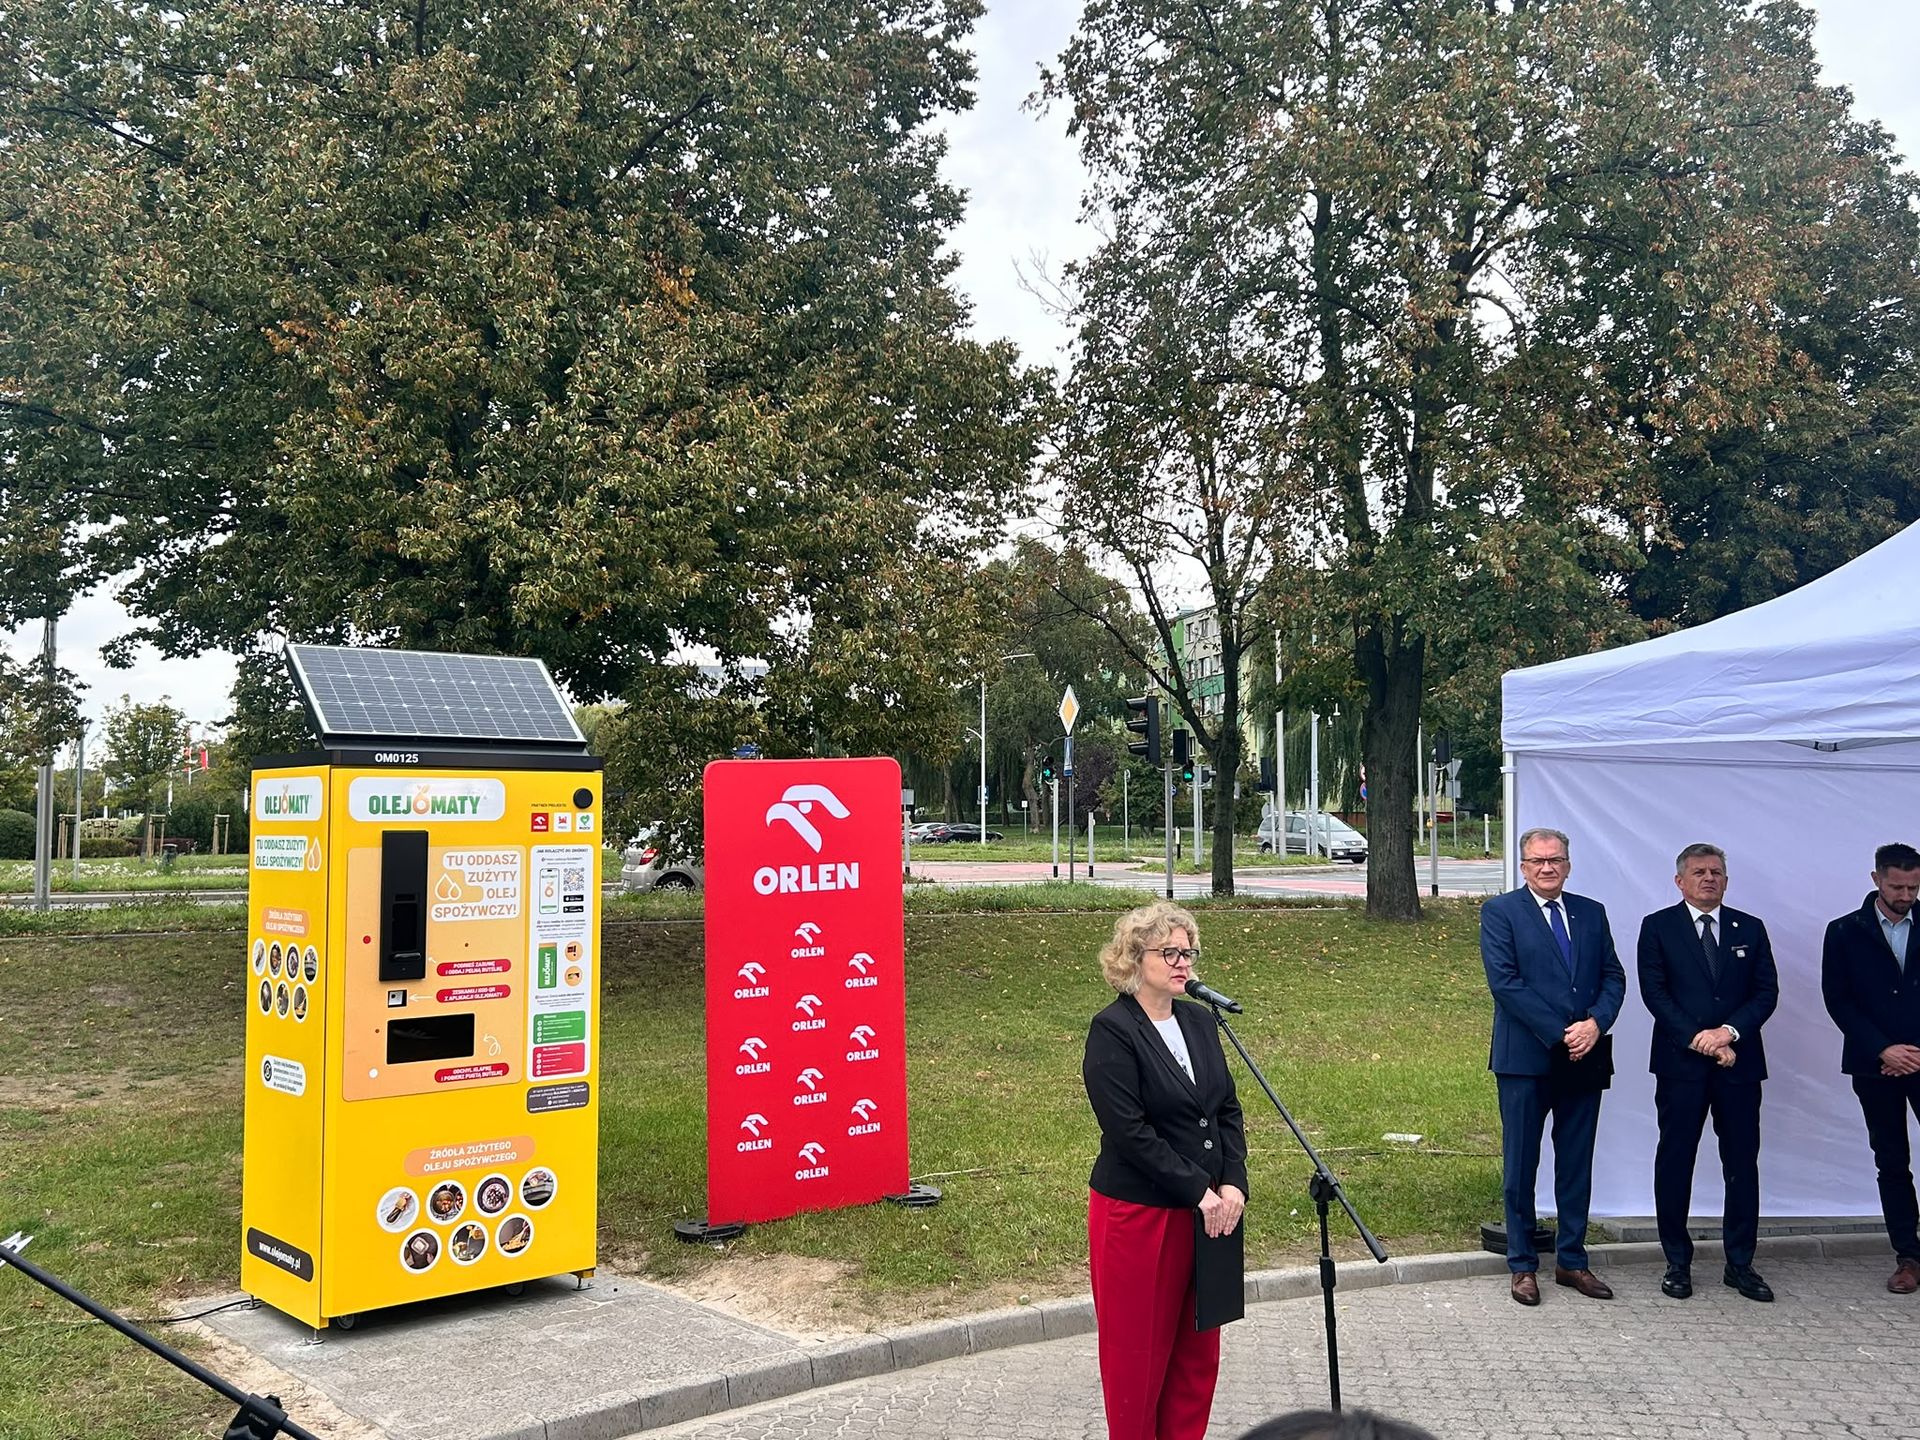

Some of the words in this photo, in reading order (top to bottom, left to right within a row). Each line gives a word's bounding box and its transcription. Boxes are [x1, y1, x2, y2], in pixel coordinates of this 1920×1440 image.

[375, 753, 418, 763] OM0125
[368, 794, 481, 815] OLEJOMATY
[446, 855, 463, 866] TU
[467, 854, 517, 866] ODDASZ
[468, 869, 517, 882] ZUŻYTY
[753, 862, 860, 896] ORLEN
[487, 888, 516, 899] OLEJ
[435, 904, 516, 918] SPOŻYWCZY!
[791, 946, 825, 959] ORLEN
[845, 976, 878, 989] ORLEN
[734, 986, 769, 999] ORLEN
[792, 1018, 826, 1032] ORLEN
[846, 1049, 879, 1062] ORLEN
[736, 1062, 771, 1075] ORLEN
[793, 1092, 827, 1106] ORLEN
[848, 1122, 881, 1137] ORLEN
[467, 1141, 512, 1154] ZUŻYTEGO
[737, 1138, 772, 1153] ORLEN
[423, 1160, 452, 1172] OLEJU
[453, 1152, 517, 1168] SPOŻYWCZEGO
[795, 1166, 829, 1181] ORLEN
